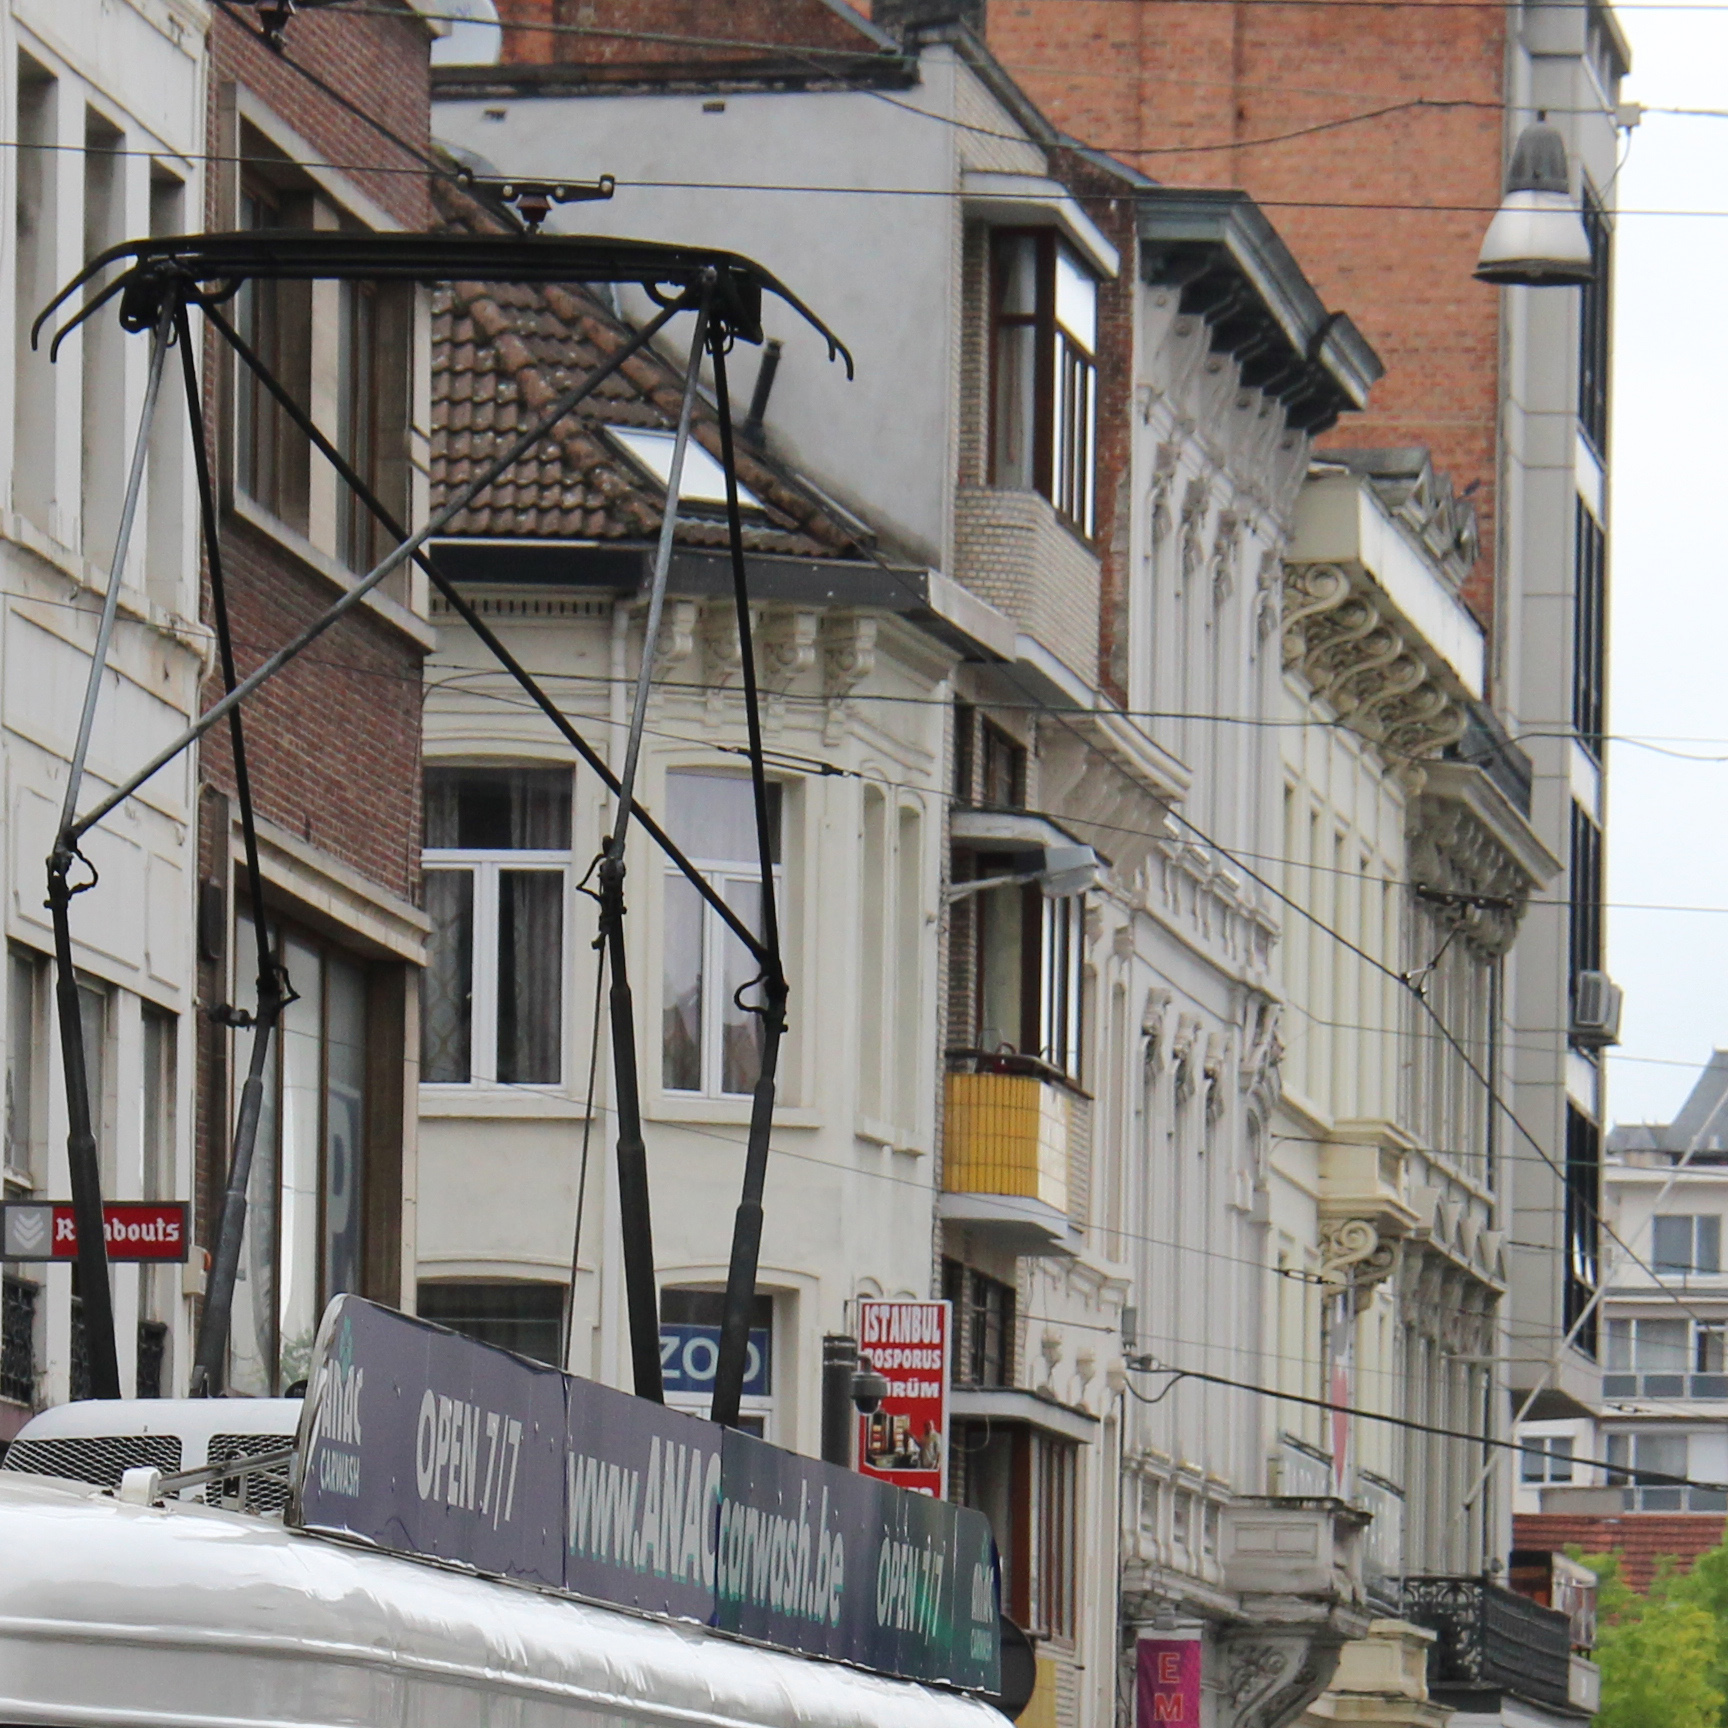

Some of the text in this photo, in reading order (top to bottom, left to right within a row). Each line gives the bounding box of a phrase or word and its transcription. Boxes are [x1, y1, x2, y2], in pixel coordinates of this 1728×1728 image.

[56, 1217, 180, 1242] Rbouts
[864, 1305, 941, 1344] ISTANBUL
[417, 1389, 522, 1531] OPEN 7/7
[877, 1537, 919, 1632] OPEN
